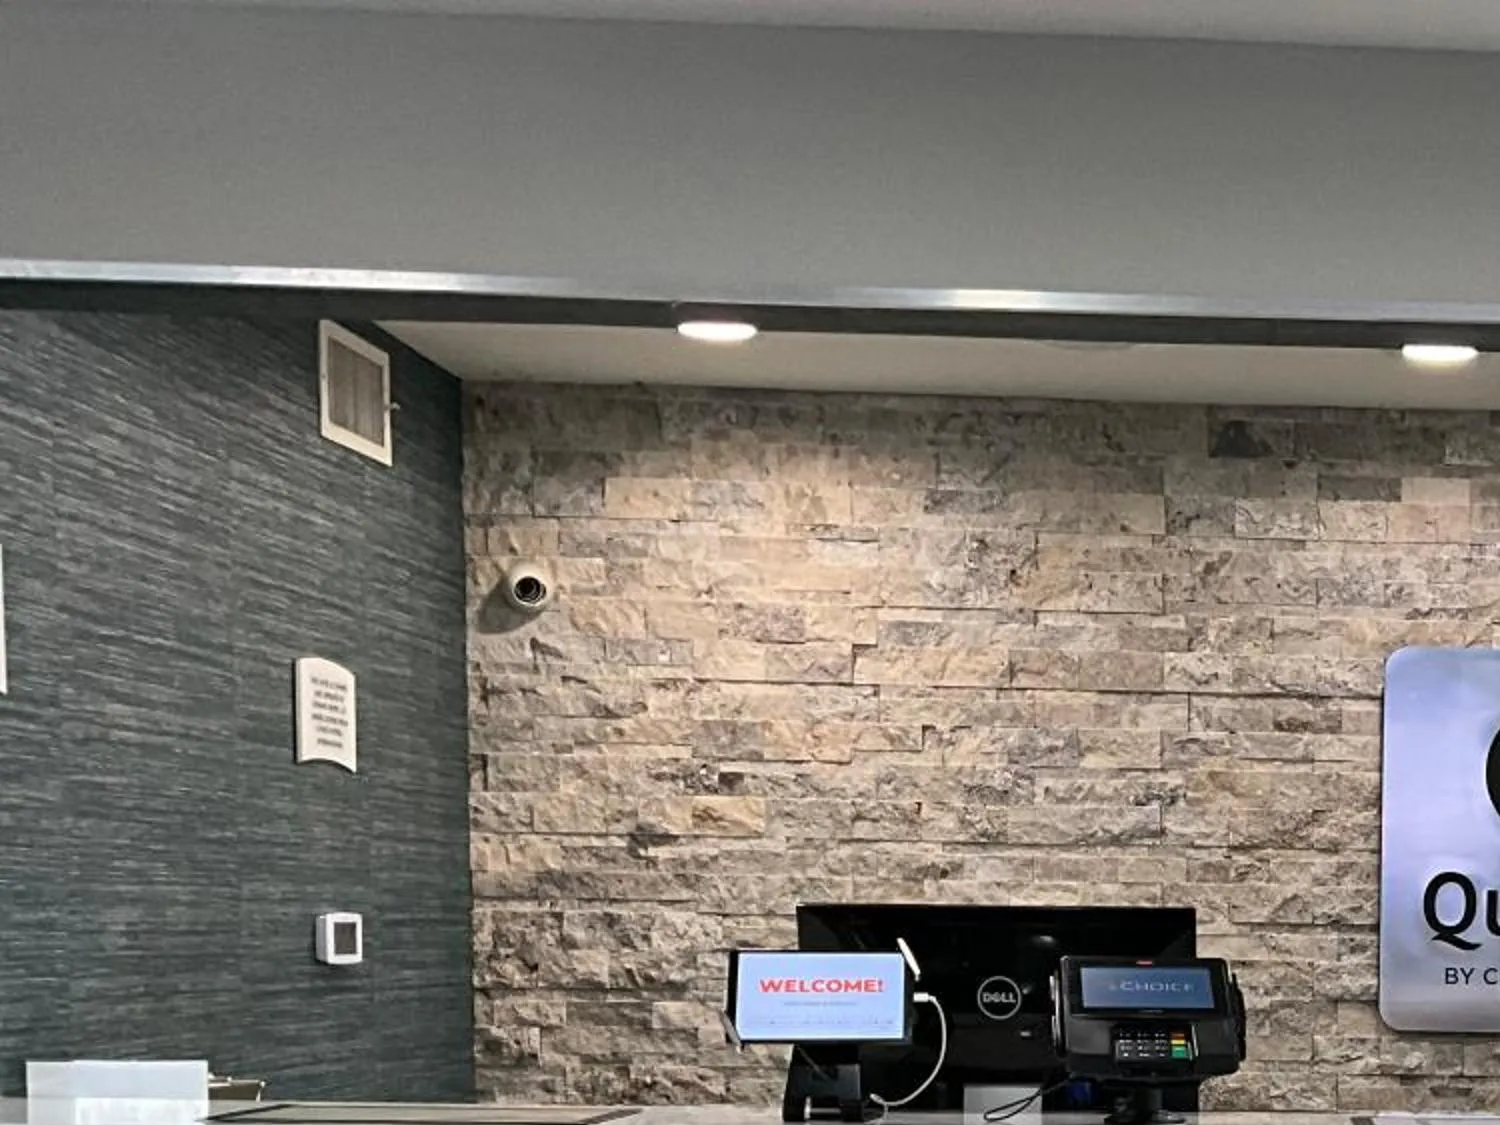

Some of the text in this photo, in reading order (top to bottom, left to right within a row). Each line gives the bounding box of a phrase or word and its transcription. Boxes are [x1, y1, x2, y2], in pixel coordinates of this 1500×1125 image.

[1444, 967, 1475, 985] BY
[760, 979, 884, 993] WELCOME!
[983, 991, 1017, 1003] DELL
